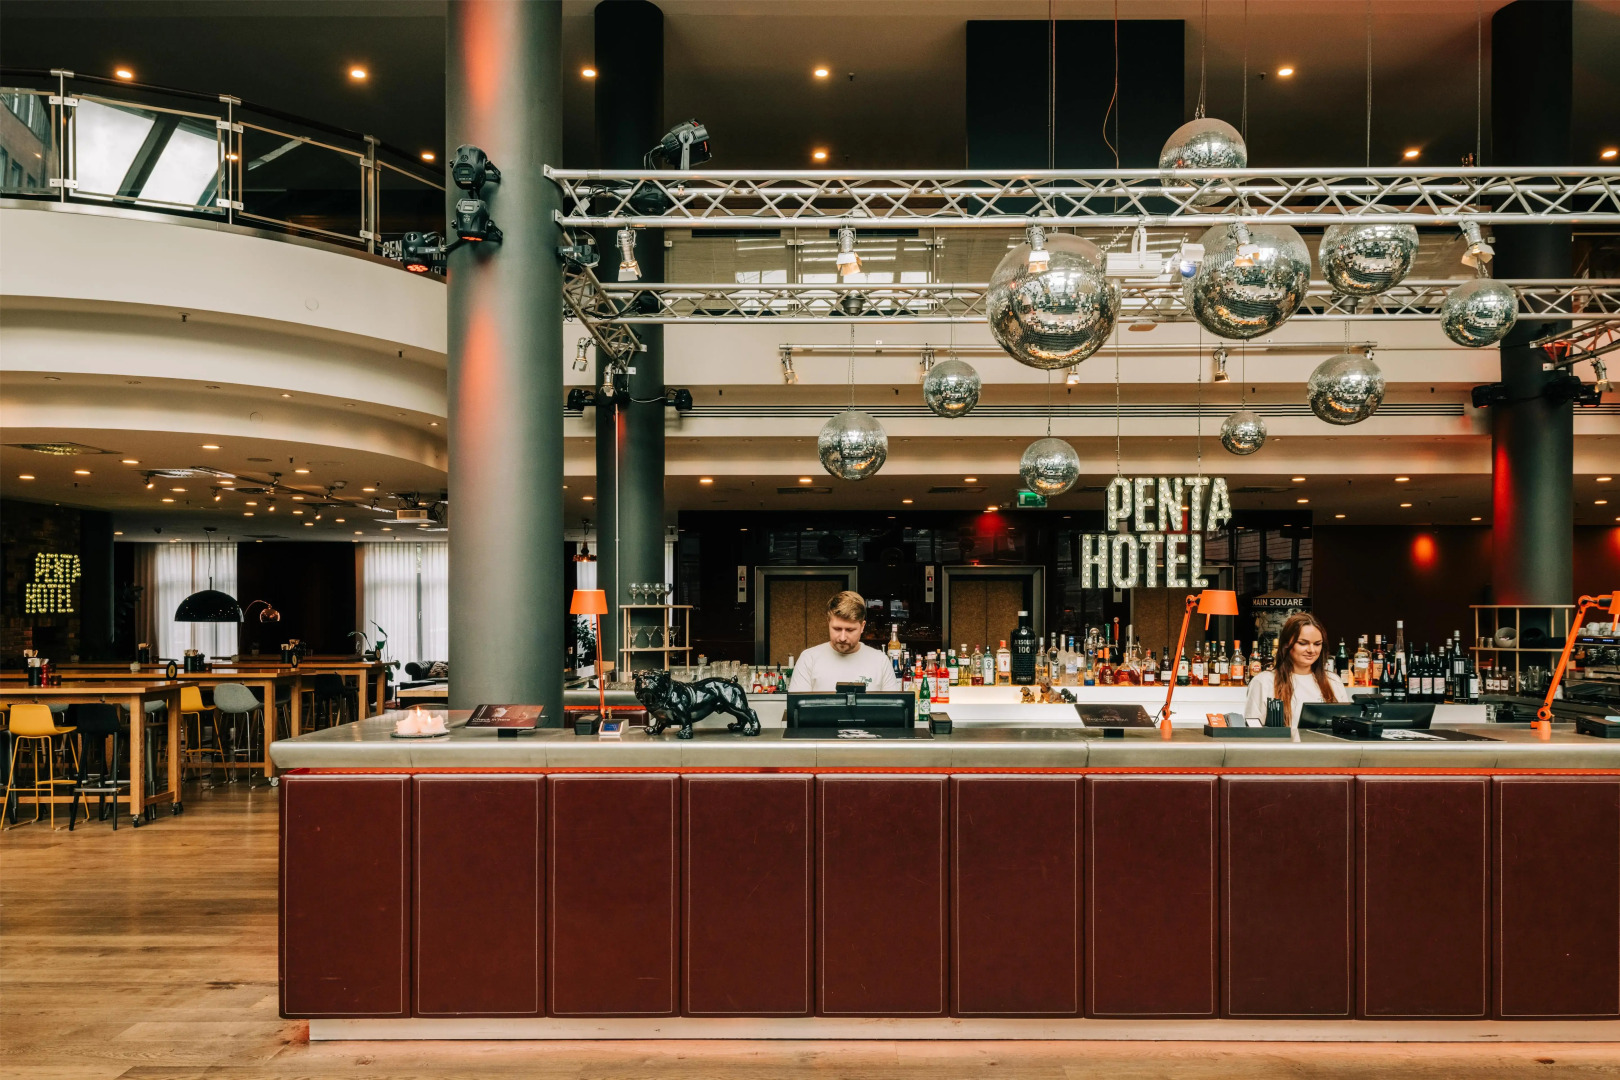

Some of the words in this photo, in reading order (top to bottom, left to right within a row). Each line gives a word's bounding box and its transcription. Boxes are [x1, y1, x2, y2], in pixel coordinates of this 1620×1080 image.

[1106, 477, 1232, 531] PENTA
[35, 552, 81, 583] PENTA
[1081, 534, 1209, 588] HOTEL
[25, 583, 74, 613] HOTEL
